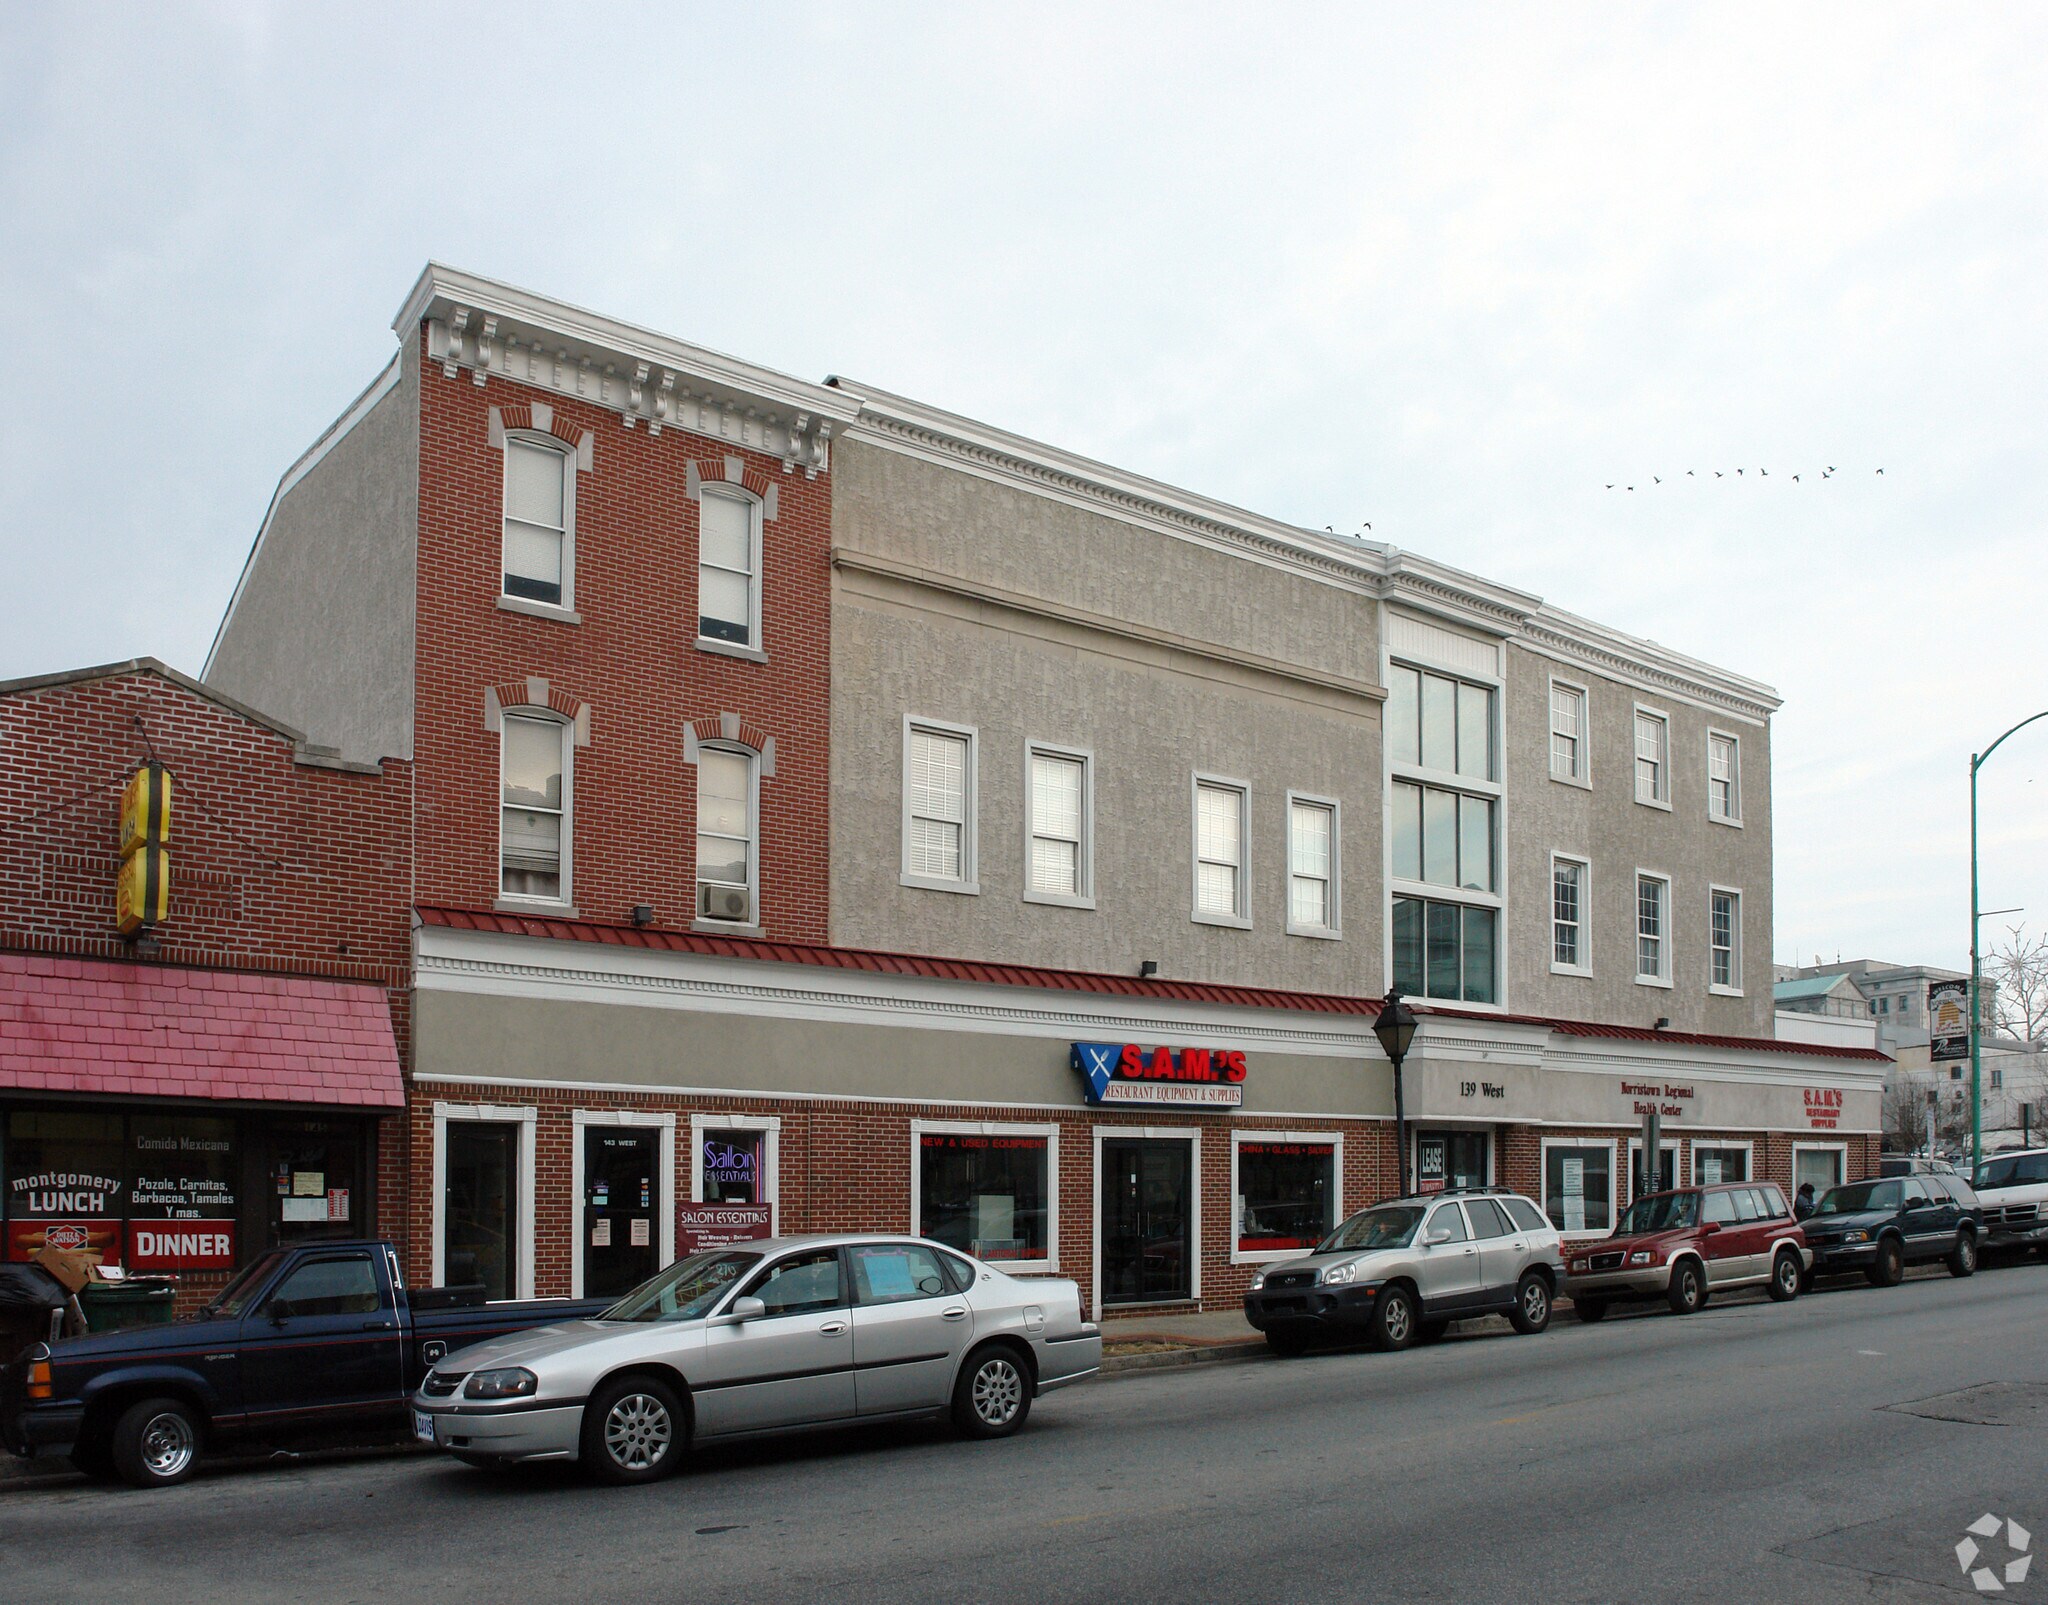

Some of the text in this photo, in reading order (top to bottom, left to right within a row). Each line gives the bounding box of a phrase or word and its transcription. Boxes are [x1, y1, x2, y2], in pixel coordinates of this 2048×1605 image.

[1932, 984, 1965, 996] WELCOME
[1105, 1084, 1240, 1102] RESTAURANT EQUIPMENT & SUPPLIES
[1460, 1081, 1505, 1098] 139 West
[1621, 1081, 1694, 1100] Norristown Regional
[1633, 1101, 1682, 1116] Health Center
[1806, 1108, 1841, 1118] RESTAURANT
[137, 1136, 230, 1151] Comida Mexicana
[920, 1137, 1048, 1149] NEW & USED EQUIPMENT
[1238, 1145, 1334, 1155] CHINA GLASS SILVER
[1422, 1147, 1442, 1173] LEASE
[12, 1171, 121, 1194] montgomery
[704, 1170, 756, 1182] ESSENTIALS
[138, 1177, 229, 1192] Pozole, Carnitas,
[29, 1191, 104, 1212] LUNCH
[132, 1191, 234, 1205] Barbacoa, Tamales
[166, 1206, 202, 1218] Y mas.
[681, 1211, 769, 1224] SALON ESSENTIALS
[136, 1232, 230, 1257] DINNER
